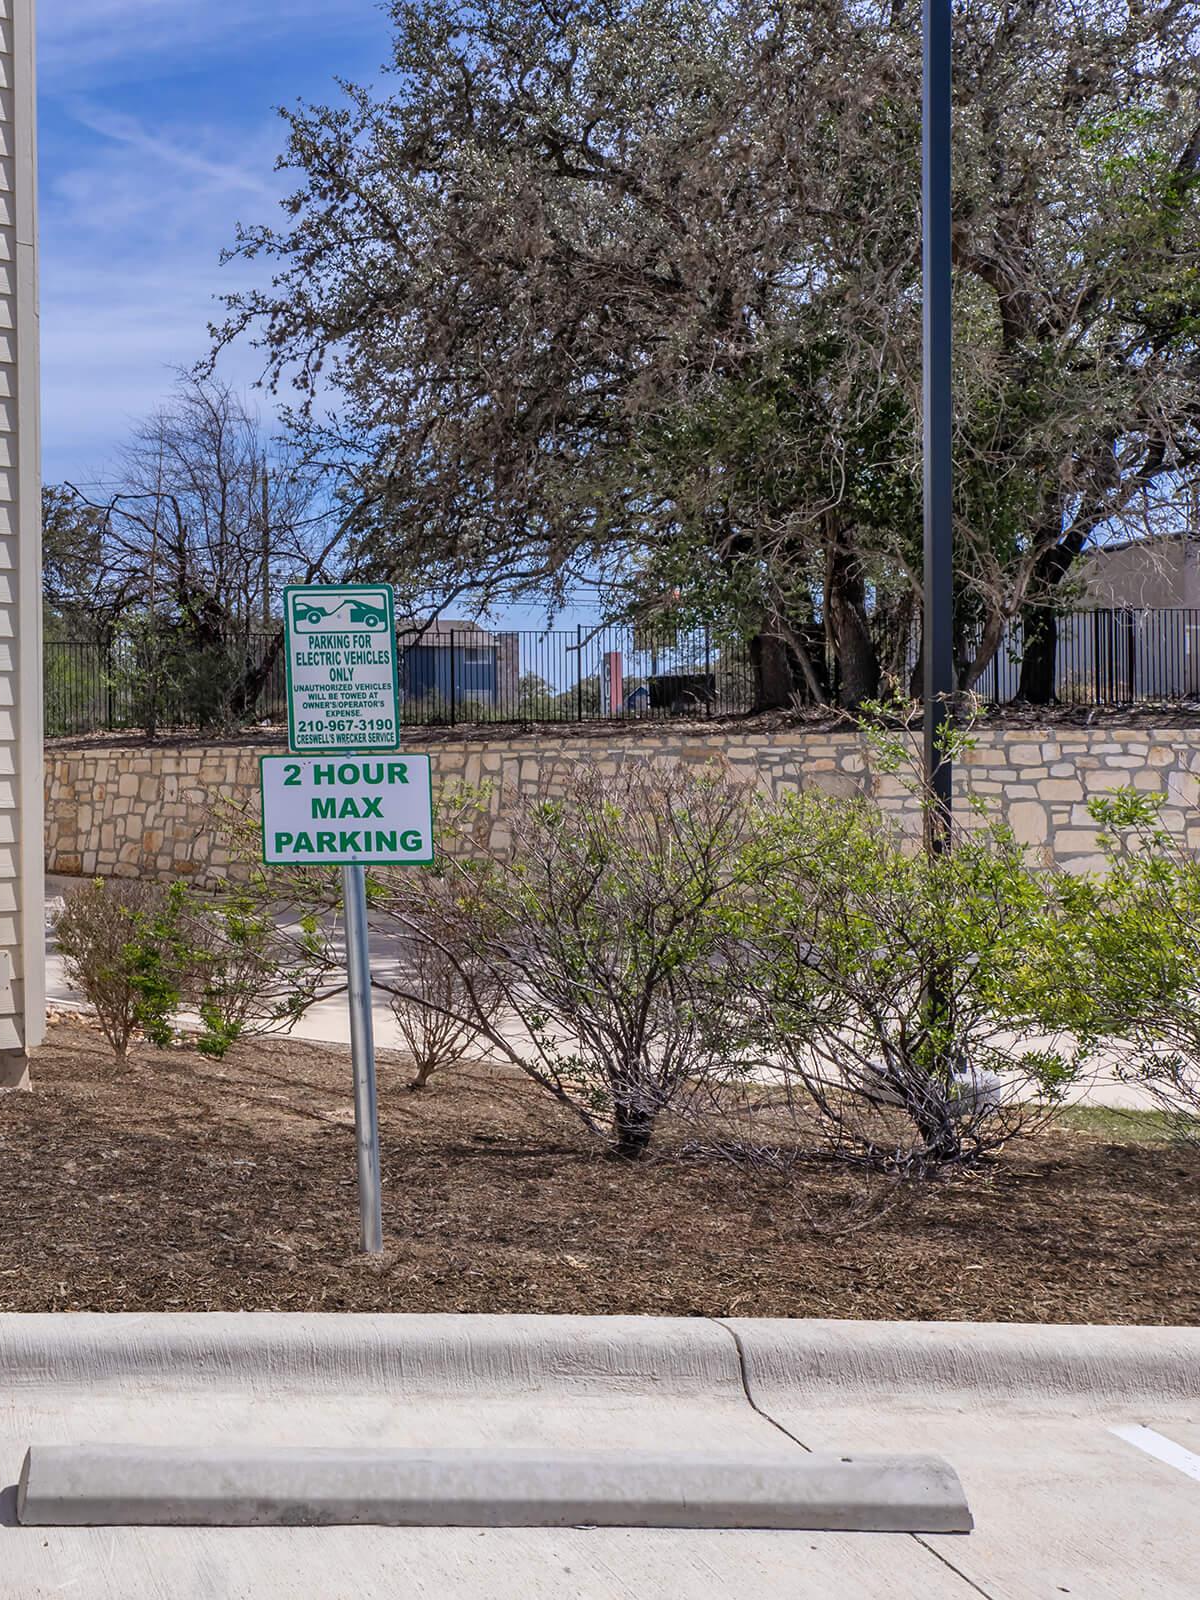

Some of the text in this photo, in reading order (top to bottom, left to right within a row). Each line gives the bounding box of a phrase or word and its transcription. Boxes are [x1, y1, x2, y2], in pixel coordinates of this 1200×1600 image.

[308, 635, 371, 649] PARKING FOR
[296, 650, 390, 666] ELECTRIC VEHICLES
[329, 667, 354, 682] ONLY
[294, 684, 353, 692] UNAUTHORIZED
[298, 719, 393, 732] 210-967-3190
[296, 732, 395, 744] CRESWELL'S WRECKER SERVICE
[283, 763, 409, 786] 2 HOUR
[311, 797, 384, 819] MAX
[275, 830, 423, 853] PARKING
